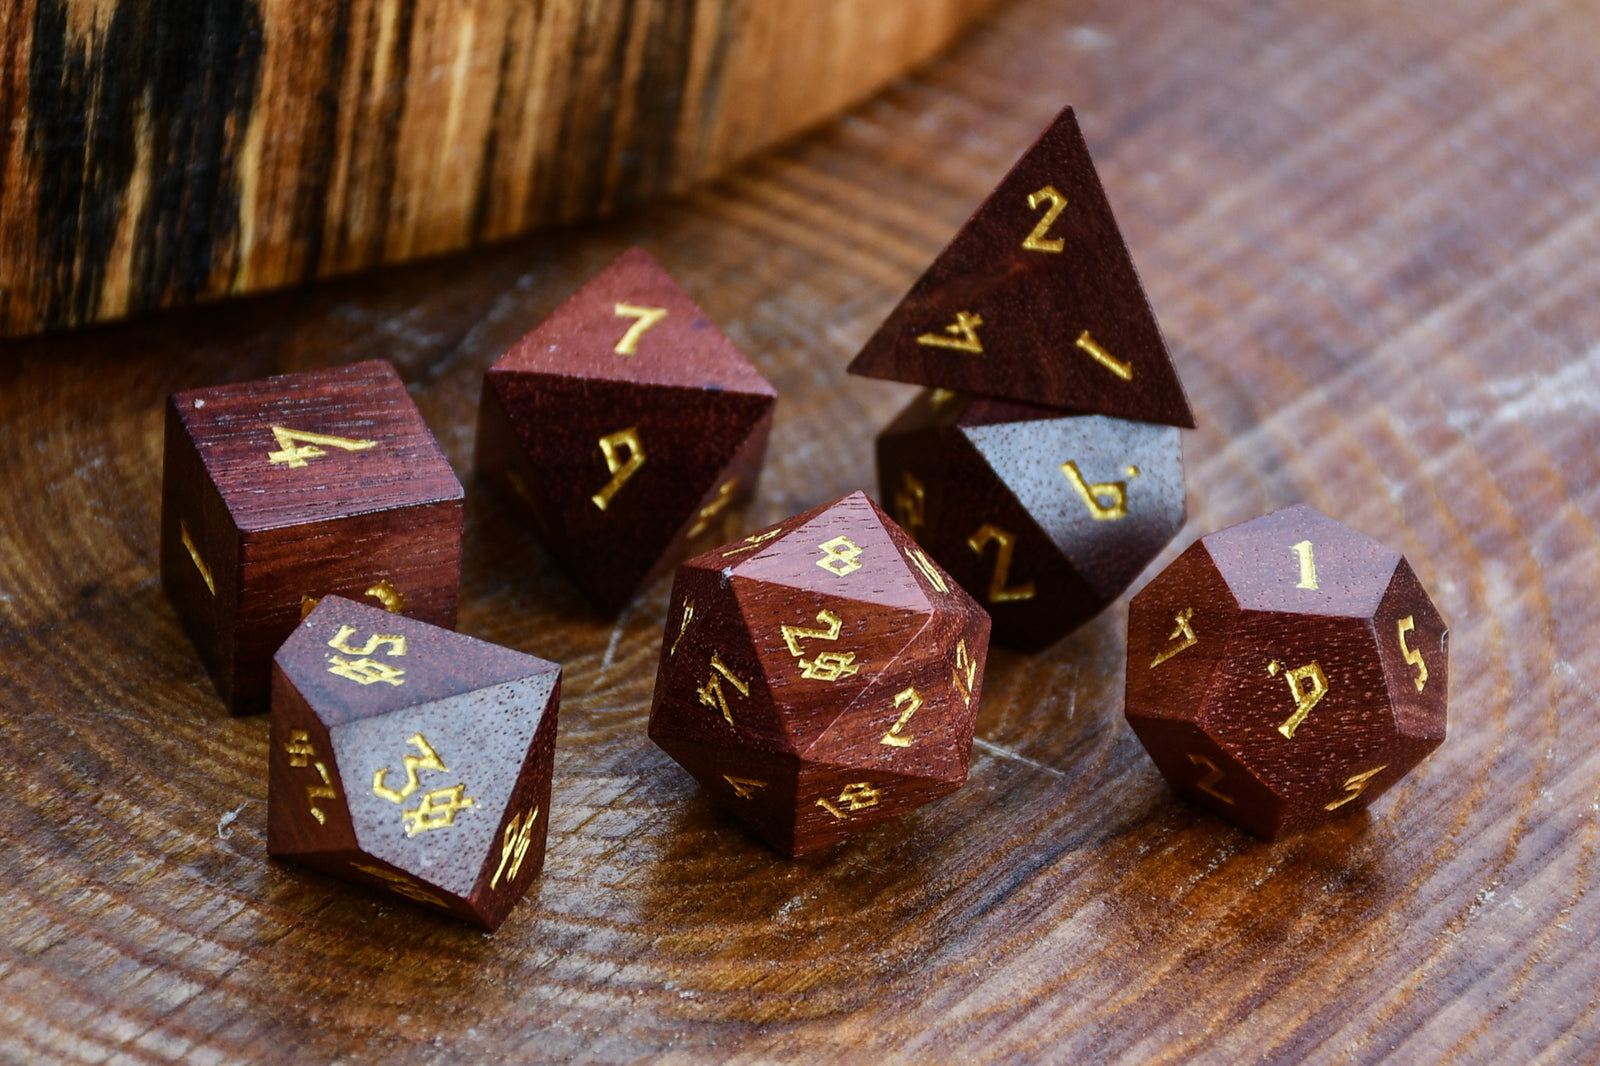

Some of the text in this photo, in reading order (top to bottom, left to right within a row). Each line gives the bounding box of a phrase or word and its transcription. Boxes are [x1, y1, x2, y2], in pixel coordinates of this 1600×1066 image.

[1022, 185, 1068, 254] 2
[614, 302, 668, 355] 7
[917, 311, 984, 353] 4
[1075, 329, 1133, 381] 1
[267, 425, 379, 469] 4
[815, 535, 863, 577] 8
[967, 524, 1035, 603] 2
[1291, 540, 1319, 591] 1
[1149, 606, 1198, 669] 4
[1398, 615, 1429, 694] 5
[879, 686, 924, 747] 2
